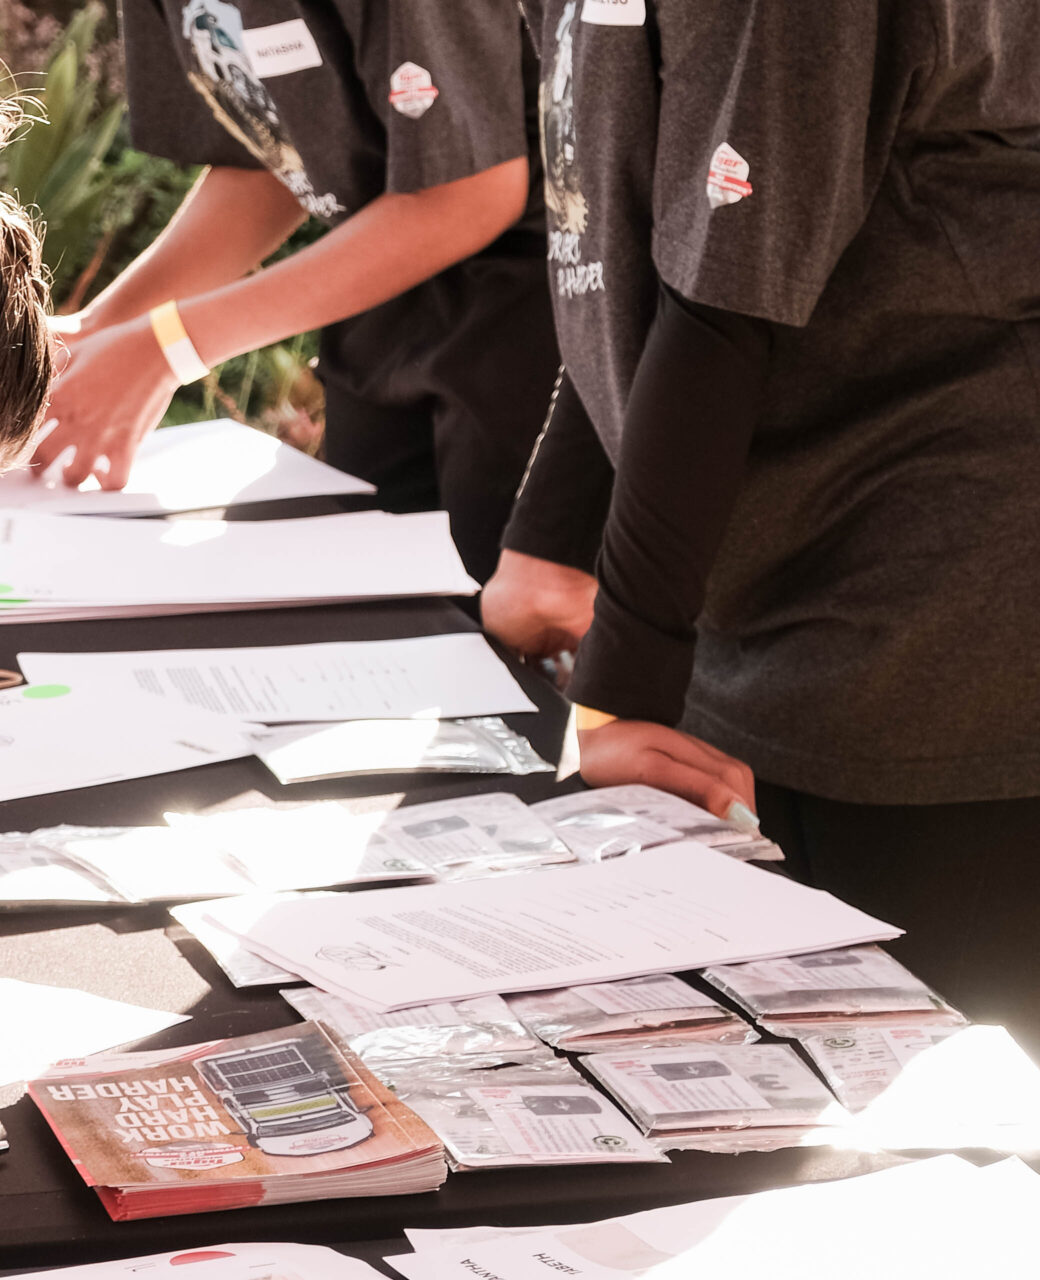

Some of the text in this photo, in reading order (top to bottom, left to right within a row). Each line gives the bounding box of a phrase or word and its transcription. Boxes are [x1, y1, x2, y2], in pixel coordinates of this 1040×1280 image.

[46, 1076, 198, 1101] HARDER
[119, 1091, 209, 1113] PLAY
[114, 1106, 220, 1128] HARD
[114, 1121, 231, 1143] WORK
[460, 1258, 504, 1280] ANTHA
